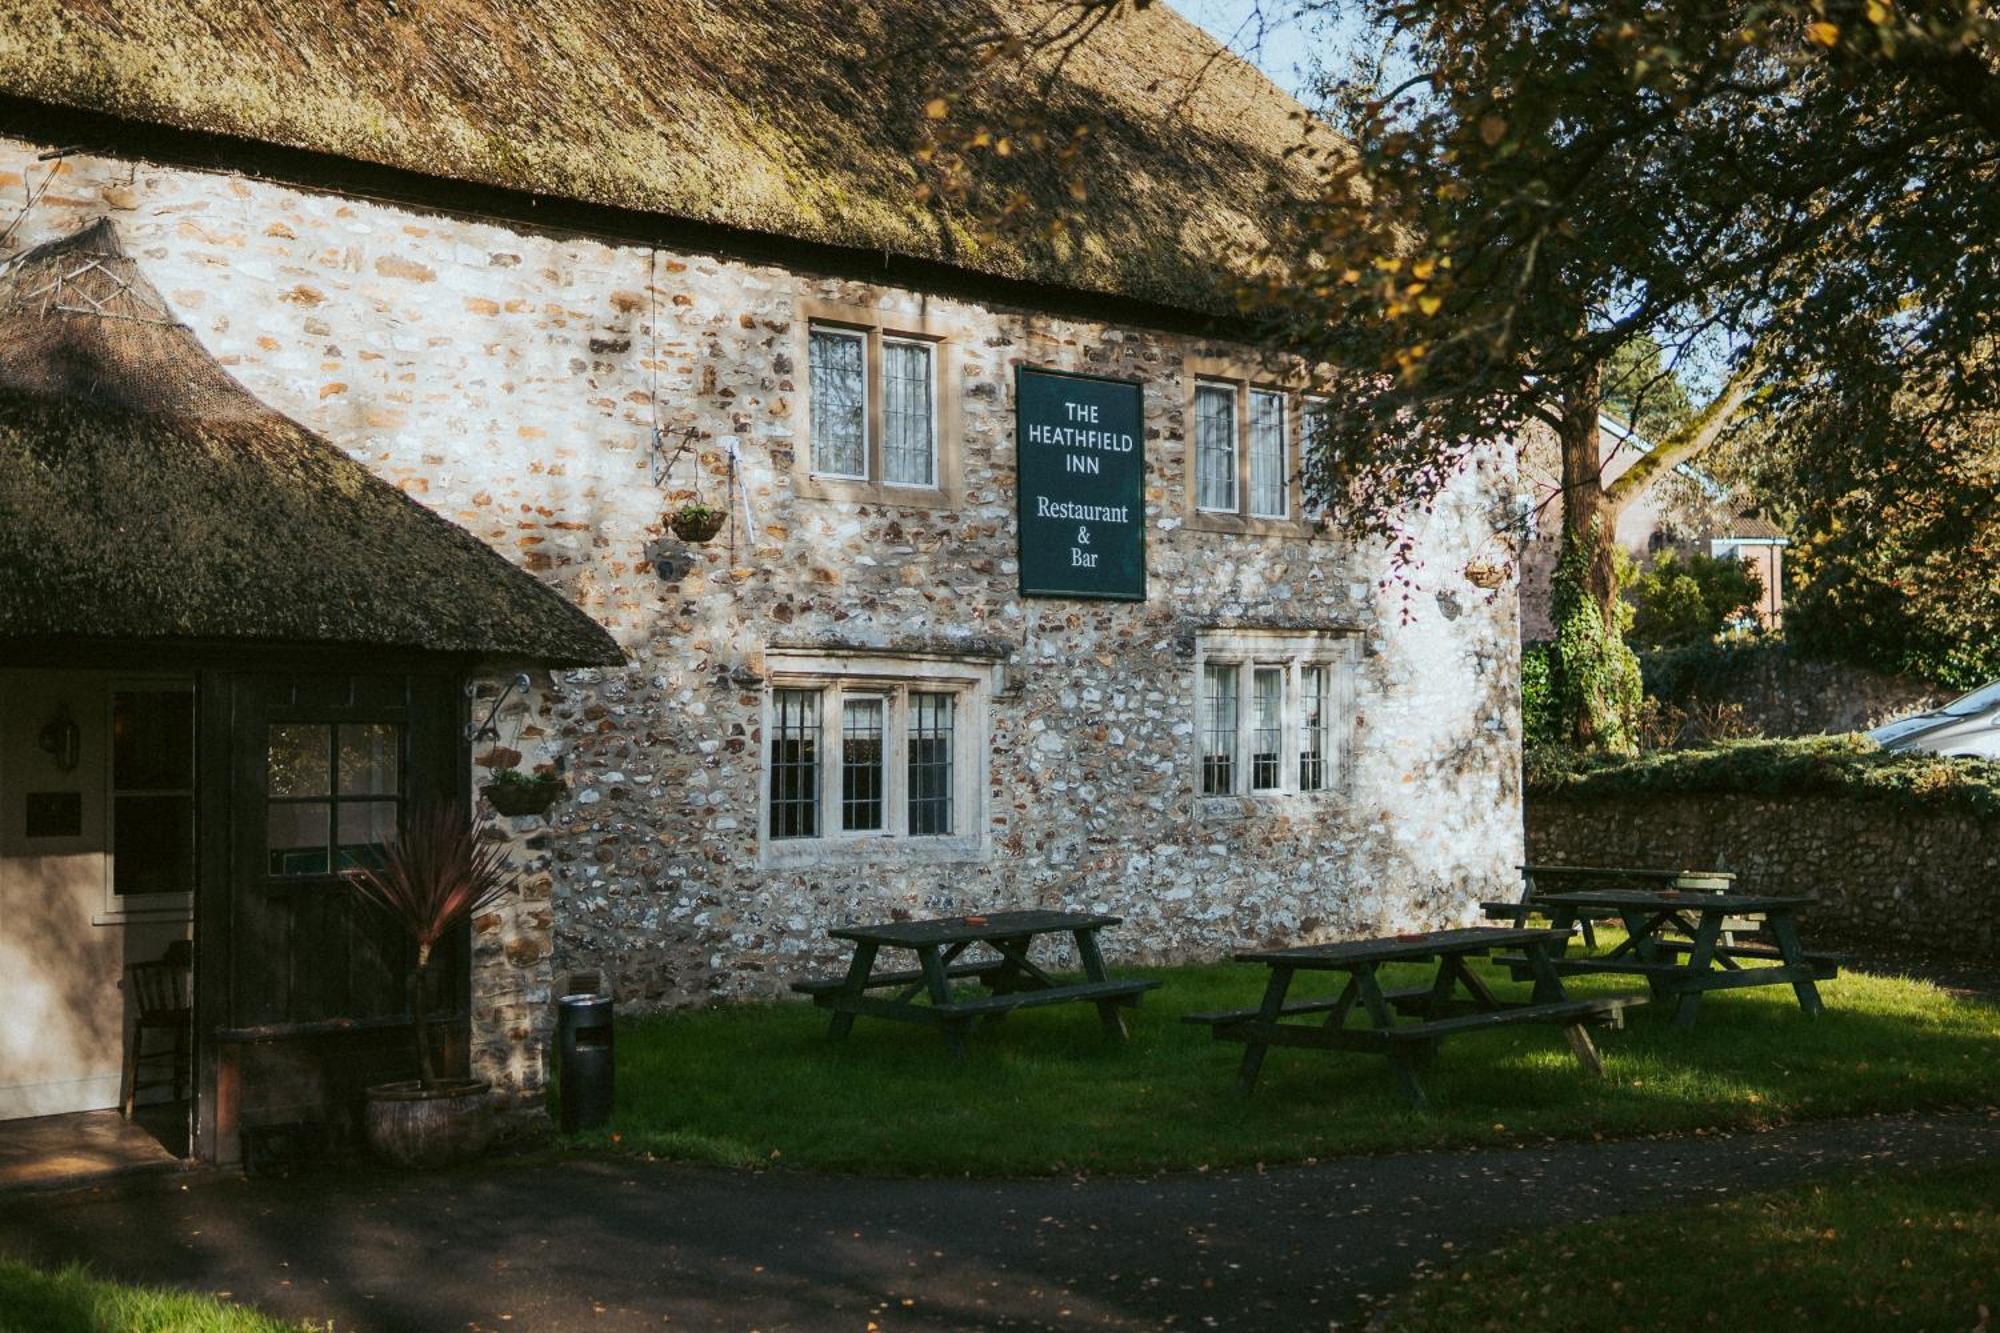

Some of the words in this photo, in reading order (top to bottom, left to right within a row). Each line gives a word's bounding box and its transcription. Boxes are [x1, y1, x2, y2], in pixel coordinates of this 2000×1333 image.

[1065, 402, 1099, 423] THE
[1029, 424, 1133, 452] HEATHFIELD
[1066, 453, 1100, 475] INN
[1037, 496, 1128, 523] Restaurant
[1077, 526, 1091, 544] &
[1071, 547, 1098, 568] Bar
